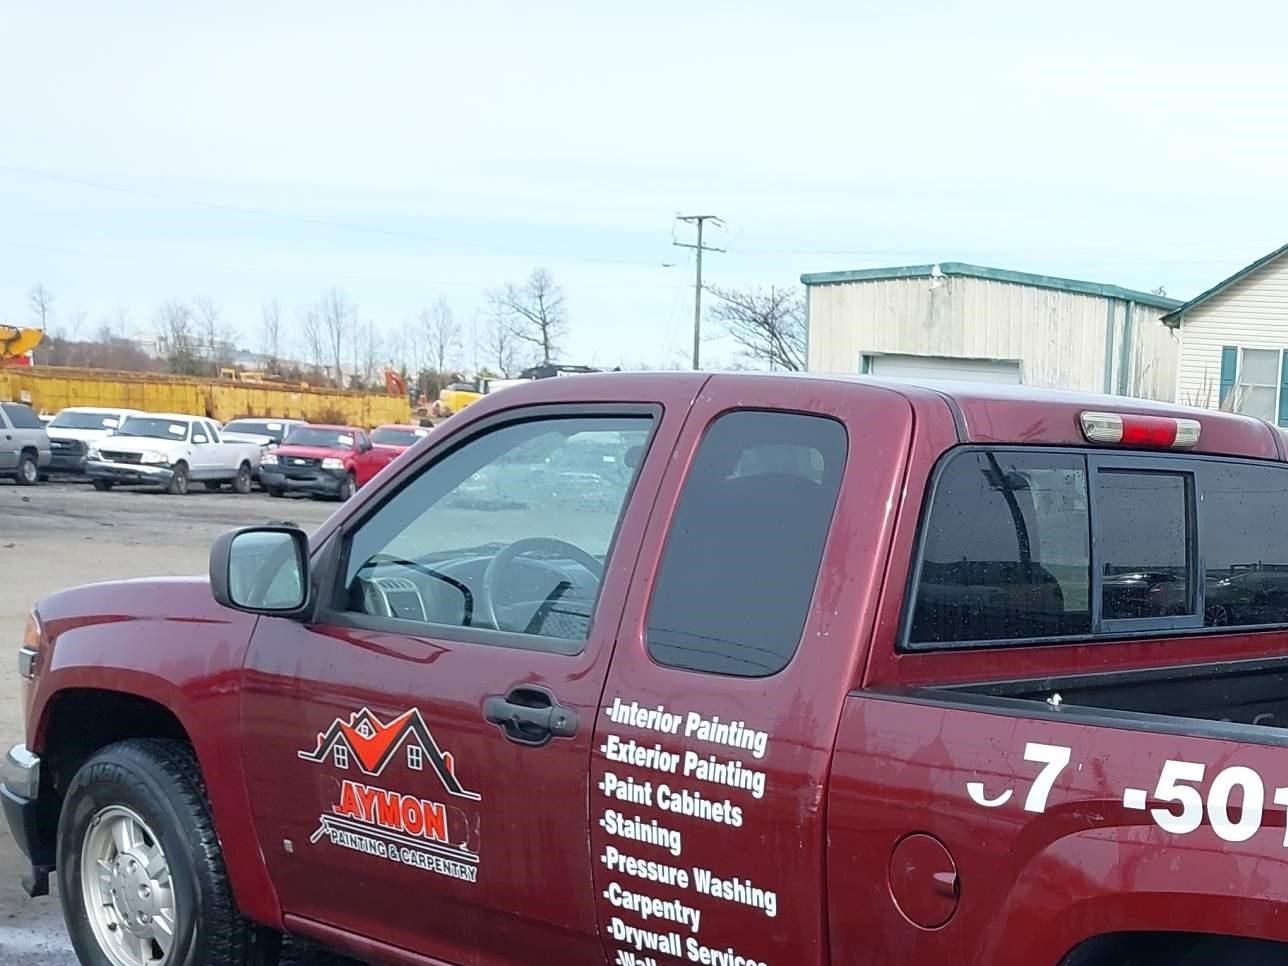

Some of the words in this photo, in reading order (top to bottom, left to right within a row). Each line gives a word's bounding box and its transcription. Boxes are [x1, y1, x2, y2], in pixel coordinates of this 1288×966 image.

[685, 711, 768, 758] Painting
[684, 751, 766, 798] Painting
[657, 784, 743, 827] Cabinets
[330, 829, 388, 858] PAINTING
[388, 844, 399, 861] &
[400, 848, 478, 882] CARPENTRY
[693, 867, 777, 917] Washing
